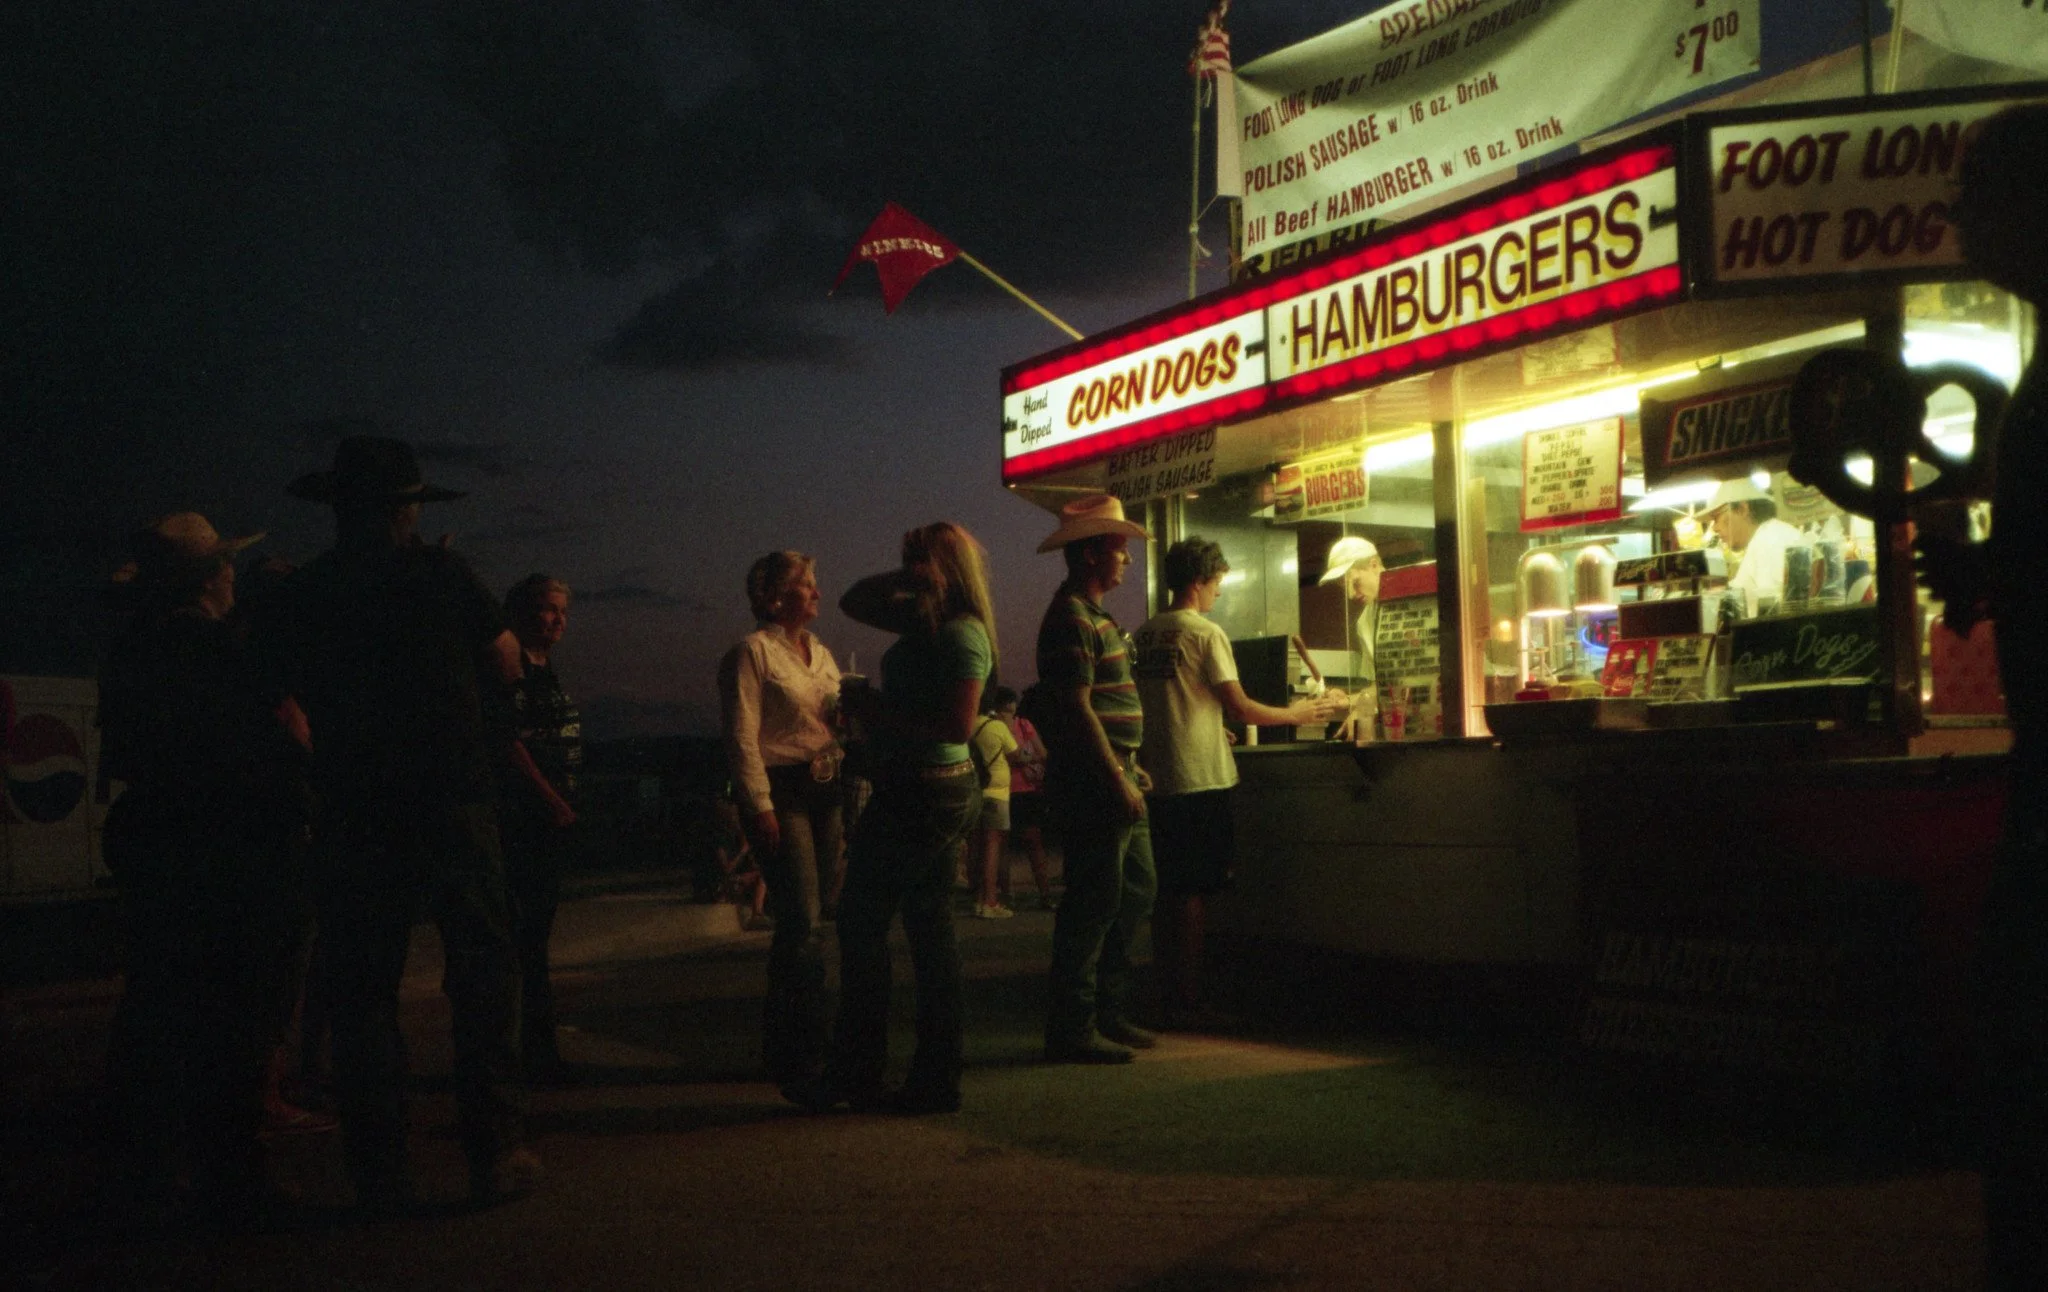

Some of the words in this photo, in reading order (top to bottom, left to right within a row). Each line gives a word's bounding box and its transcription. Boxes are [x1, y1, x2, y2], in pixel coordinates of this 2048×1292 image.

[1244, 110, 1274, 141] FOOT
[1276, 89, 1305, 127] LONG
[1312, 77, 1343, 108] DOG
[1346, 74, 1365, 95] or
[1370, 50, 1412, 87] FOOT
[1416, 30, 1460, 66] LONG
[1245, 151, 1306, 196] POLISH
[1311, 114, 1380, 172] SAUSAGE
[1409, 101, 1424, 125] 16
[1457, 71, 1499, 105] Drink
[1720, 131, 1849, 192] FOOT
[1863, 121, 1966, 179] LON
[1247, 216, 1266, 246] All
[1274, 200, 1318, 237] Beef
[1326, 156, 1434, 222] HAMBURGER
[1463, 145, 1482, 168] 16
[1516, 115, 1564, 150] Drink
[1722, 210, 1831, 270] HOT
[1291, 190, 1643, 366] HAMBURGERS
[1023, 389, 1049, 415] Hand
[1067, 361, 1149, 428] CORN
[1150, 331, 1241, 403] DOGS
[1020, 417, 1052, 446] Dipped
[1164, 427, 1215, 462] DIPPED
[1305, 467, 1365, 507] BURGERS
